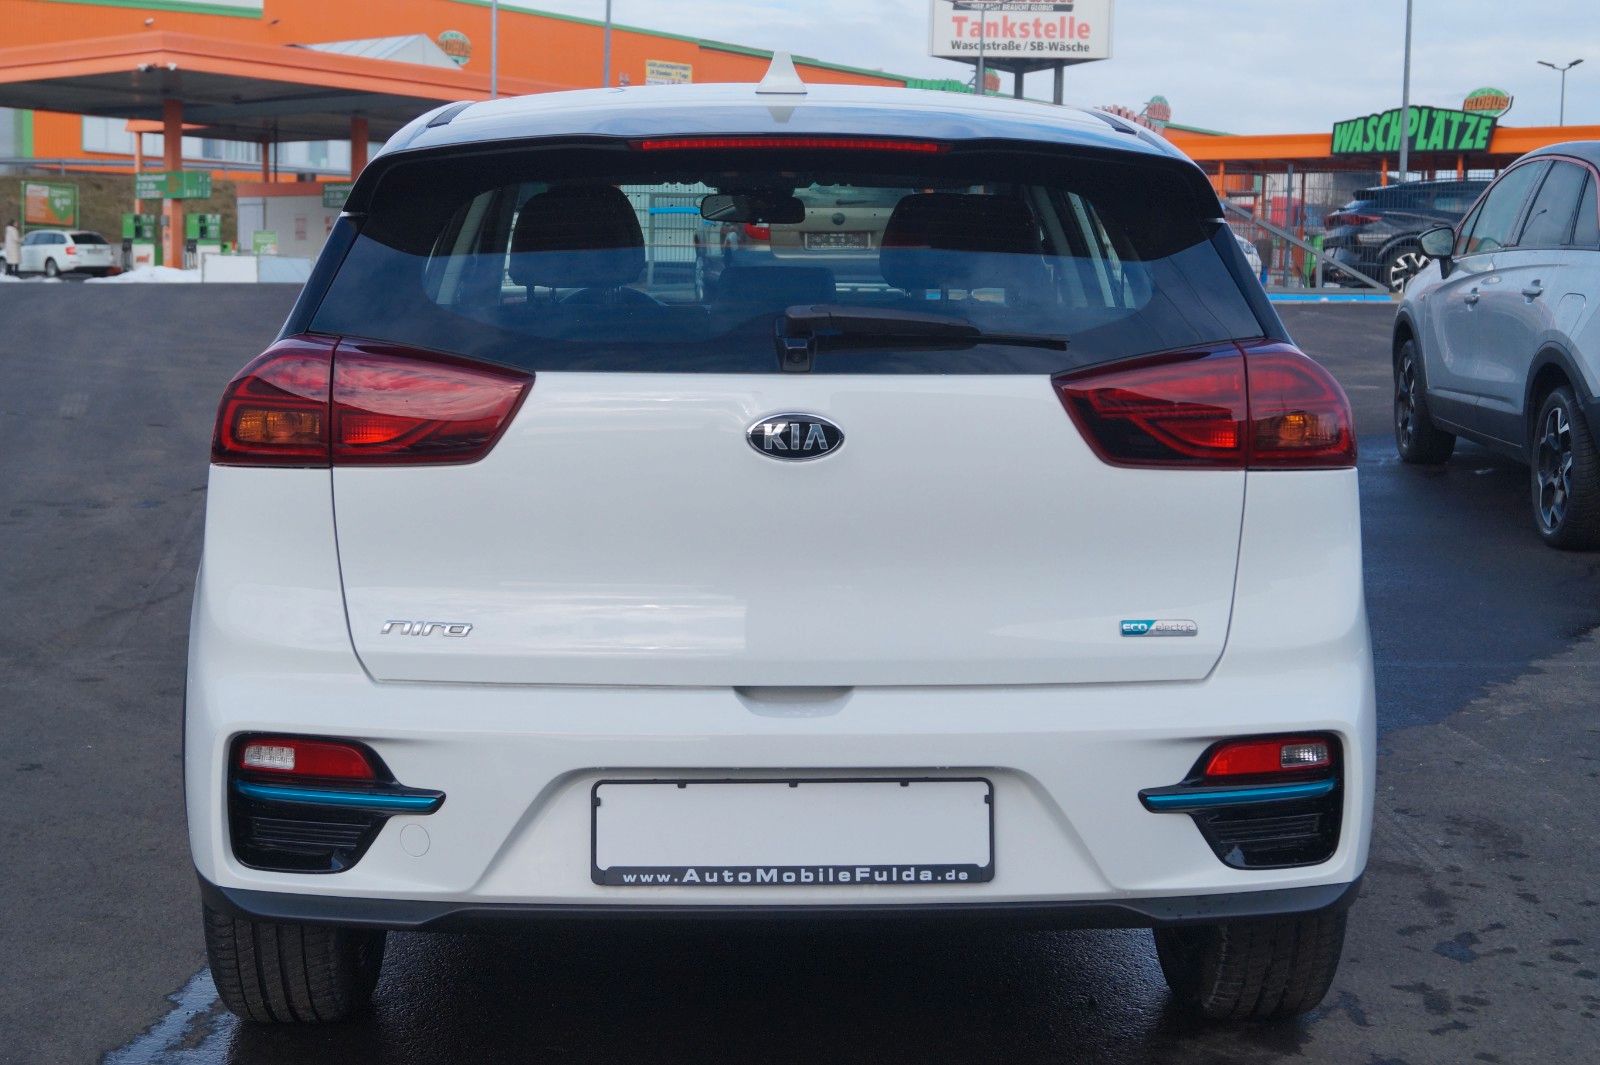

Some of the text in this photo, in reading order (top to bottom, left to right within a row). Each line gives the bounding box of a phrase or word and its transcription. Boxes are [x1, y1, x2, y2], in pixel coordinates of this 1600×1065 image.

[952, 15, 1091, 40] Tankstelle
[1030, 41, 1090, 52] SB-Wäsche
[1464, 94, 1509, 111] GLOBUS
[1333, 105, 1493, 154] WASCHPLÄTZE
[763, 423, 828, 450] KIA
[622, 866, 969, 884] www.AutoMobileFulda.de
